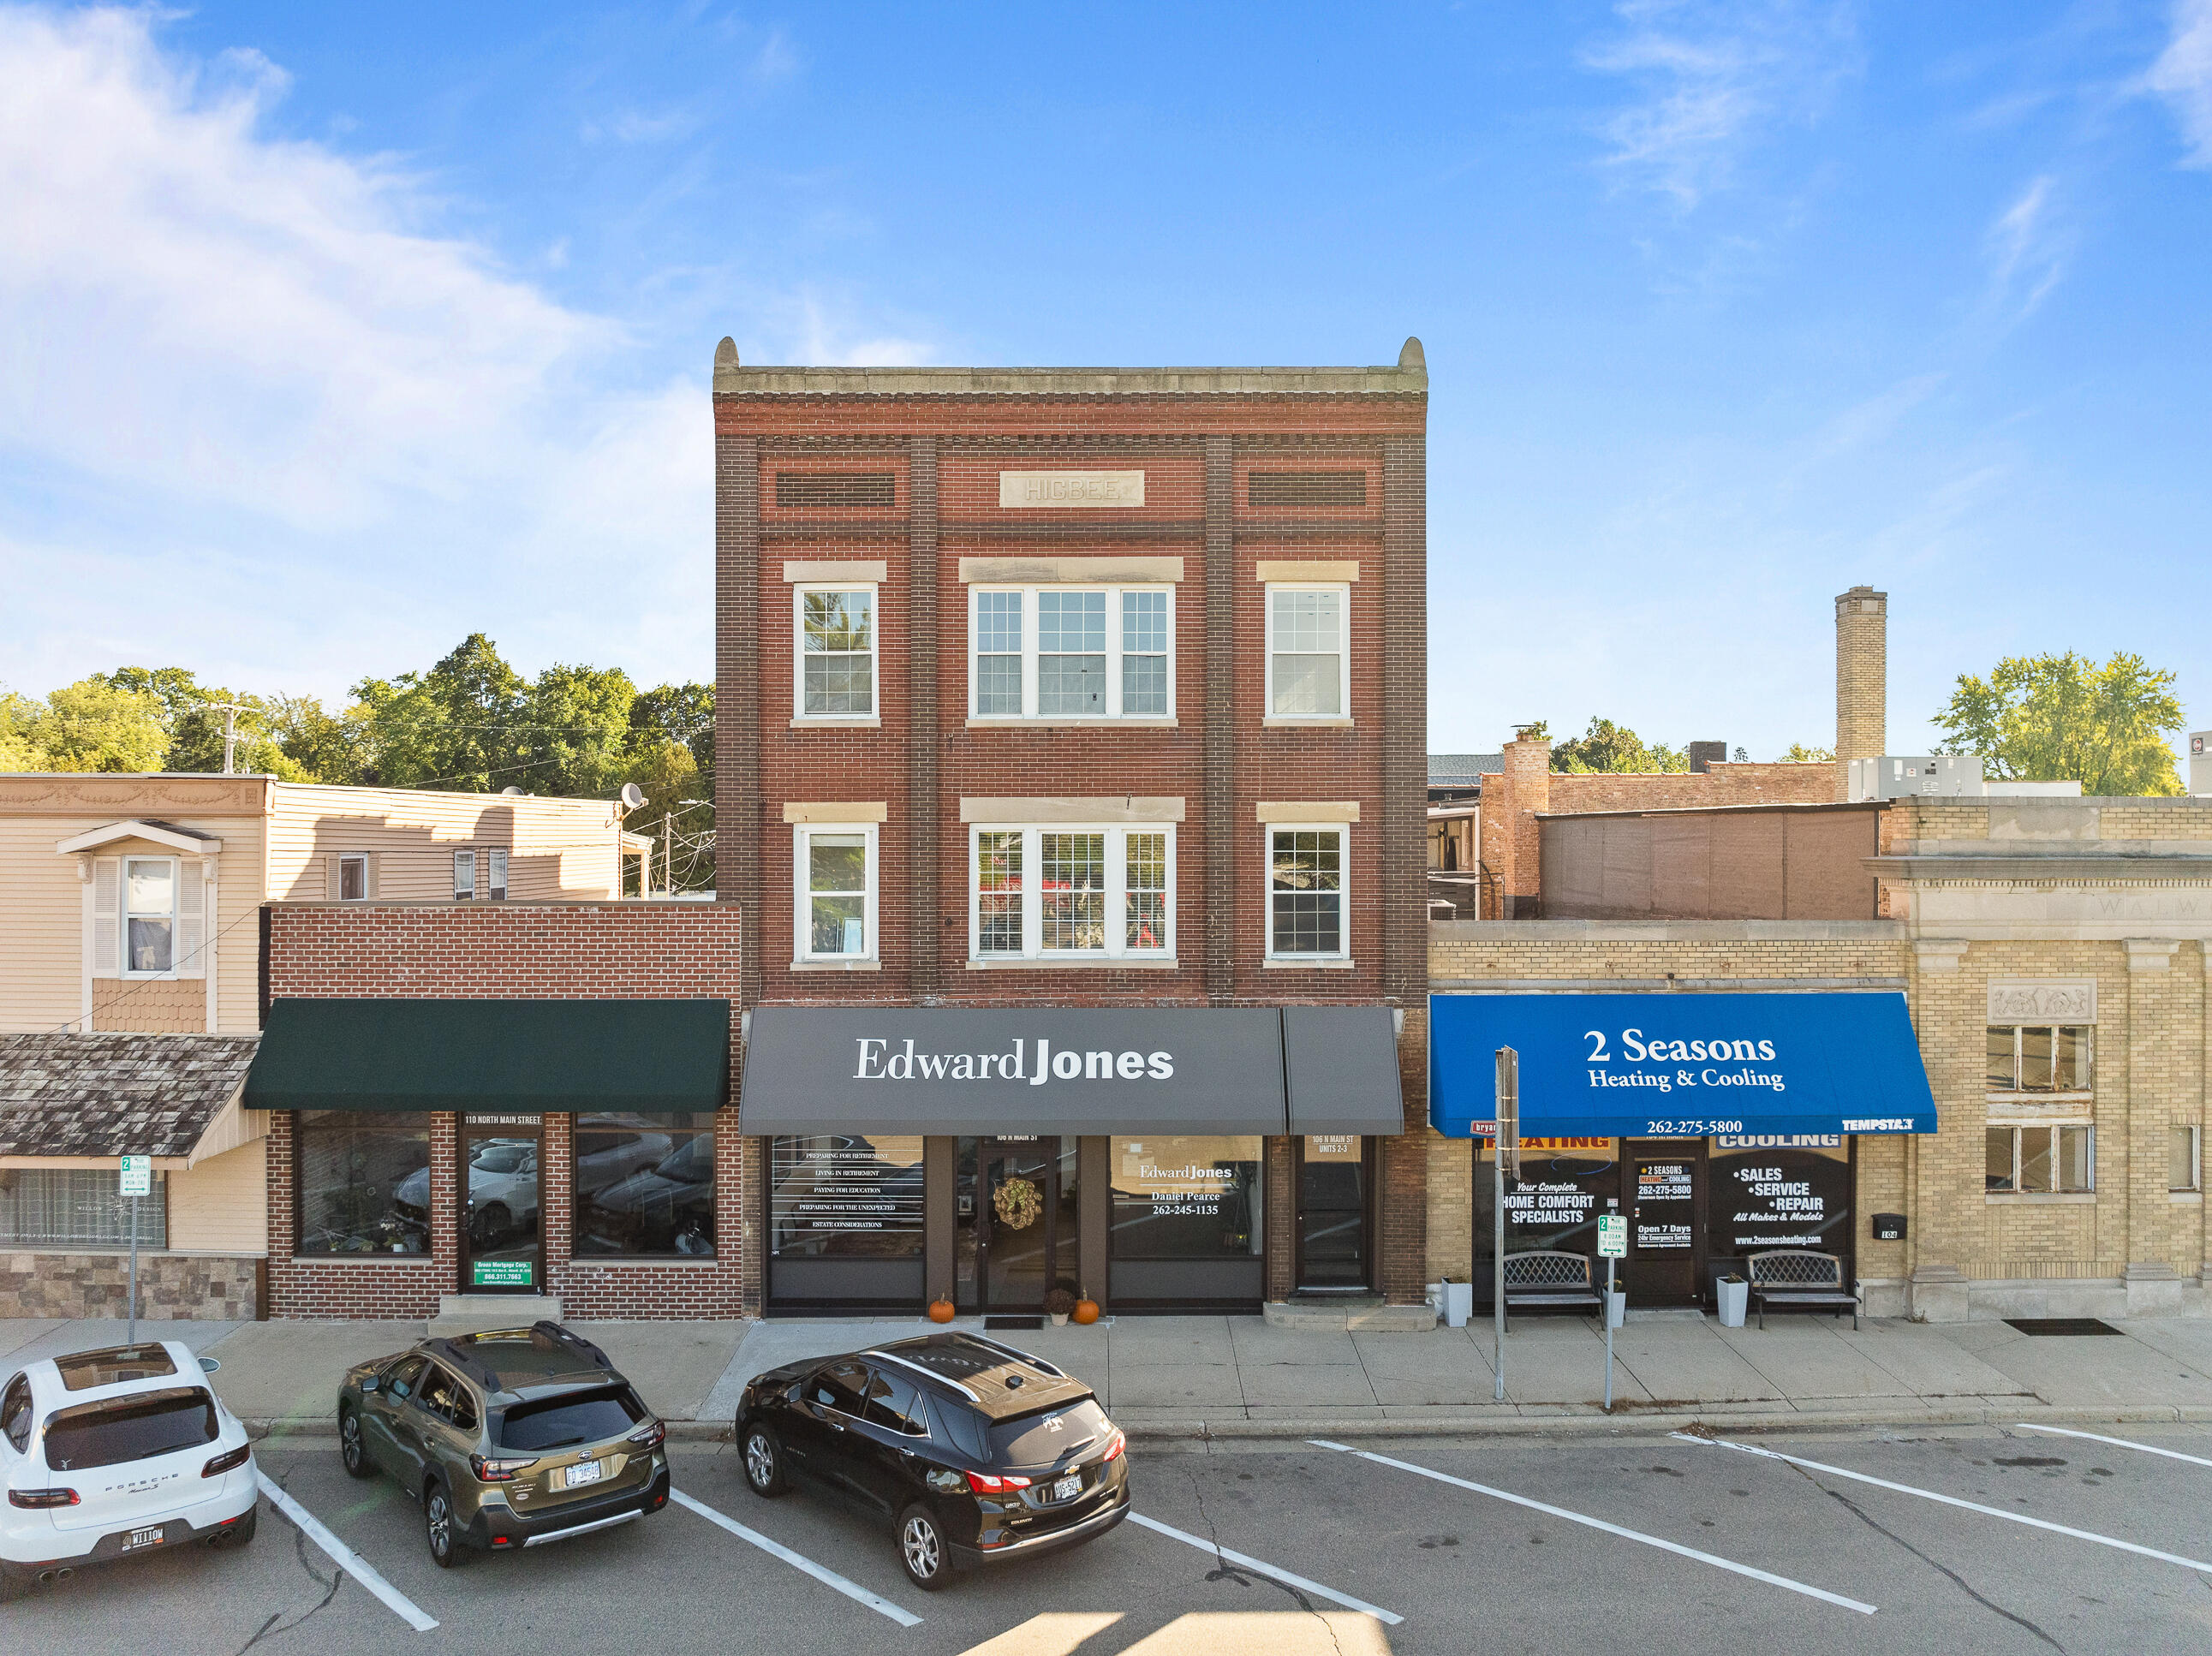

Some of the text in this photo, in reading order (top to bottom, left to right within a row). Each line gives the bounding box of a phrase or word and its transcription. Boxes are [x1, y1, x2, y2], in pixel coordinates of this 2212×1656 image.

[1026, 479, 1119, 500] HIGBEE
[2099, 897, 2212, 914] WALW
[1583, 1028, 1776, 1062] 2 Seasons
[853, 1039, 1174, 1086] Edward Jones
[1588, 1069, 1786, 1093] Heating & Cooling
[465, 1116, 541, 1124] 110 NORTH MAIN STREET
[1476, 1123, 1496, 1133] brya
[1647, 1120, 1743, 1134] 262-275-5800
[1486, 1137, 1609, 1148] ATING
[1719, 1135, 1839, 1147] COOLING
[123, 1159, 129, 1170] 2
[1648, 1165, 1683, 1175] 2 SEASONS
[1140, 1165, 1231, 1179] Edward Jones
[1740, 1168, 1782, 1182] SALES
[1517, 1182, 1577, 1194] Your Complete
[1638, 1185, 1691, 1194] 262-275-5800
[1755, 1182, 1810, 1196] SERVICE
[1151, 1192, 1220, 1200] Daniel Pearce
[1503, 1195, 1535, 1208] HOME
[1538, 1195, 1595, 1208] COMFORT
[1776, 1197, 1823, 1211] REPAIR
[1153, 1206, 1219, 1215] 262-245-1135
[1733, 1212, 1824, 1221] All Makes & Models
[1511, 1210, 1584, 1224] SPECIALISTS
[1601, 1218, 1607, 1230] 2
[1637, 1225, 1660, 1234] Open
[1670, 1224, 1691, 1234] Days
[1735, 1235, 1821, 1245] www.2seasonsheating.com
[105, 1474, 179, 1492] PORSCHE
